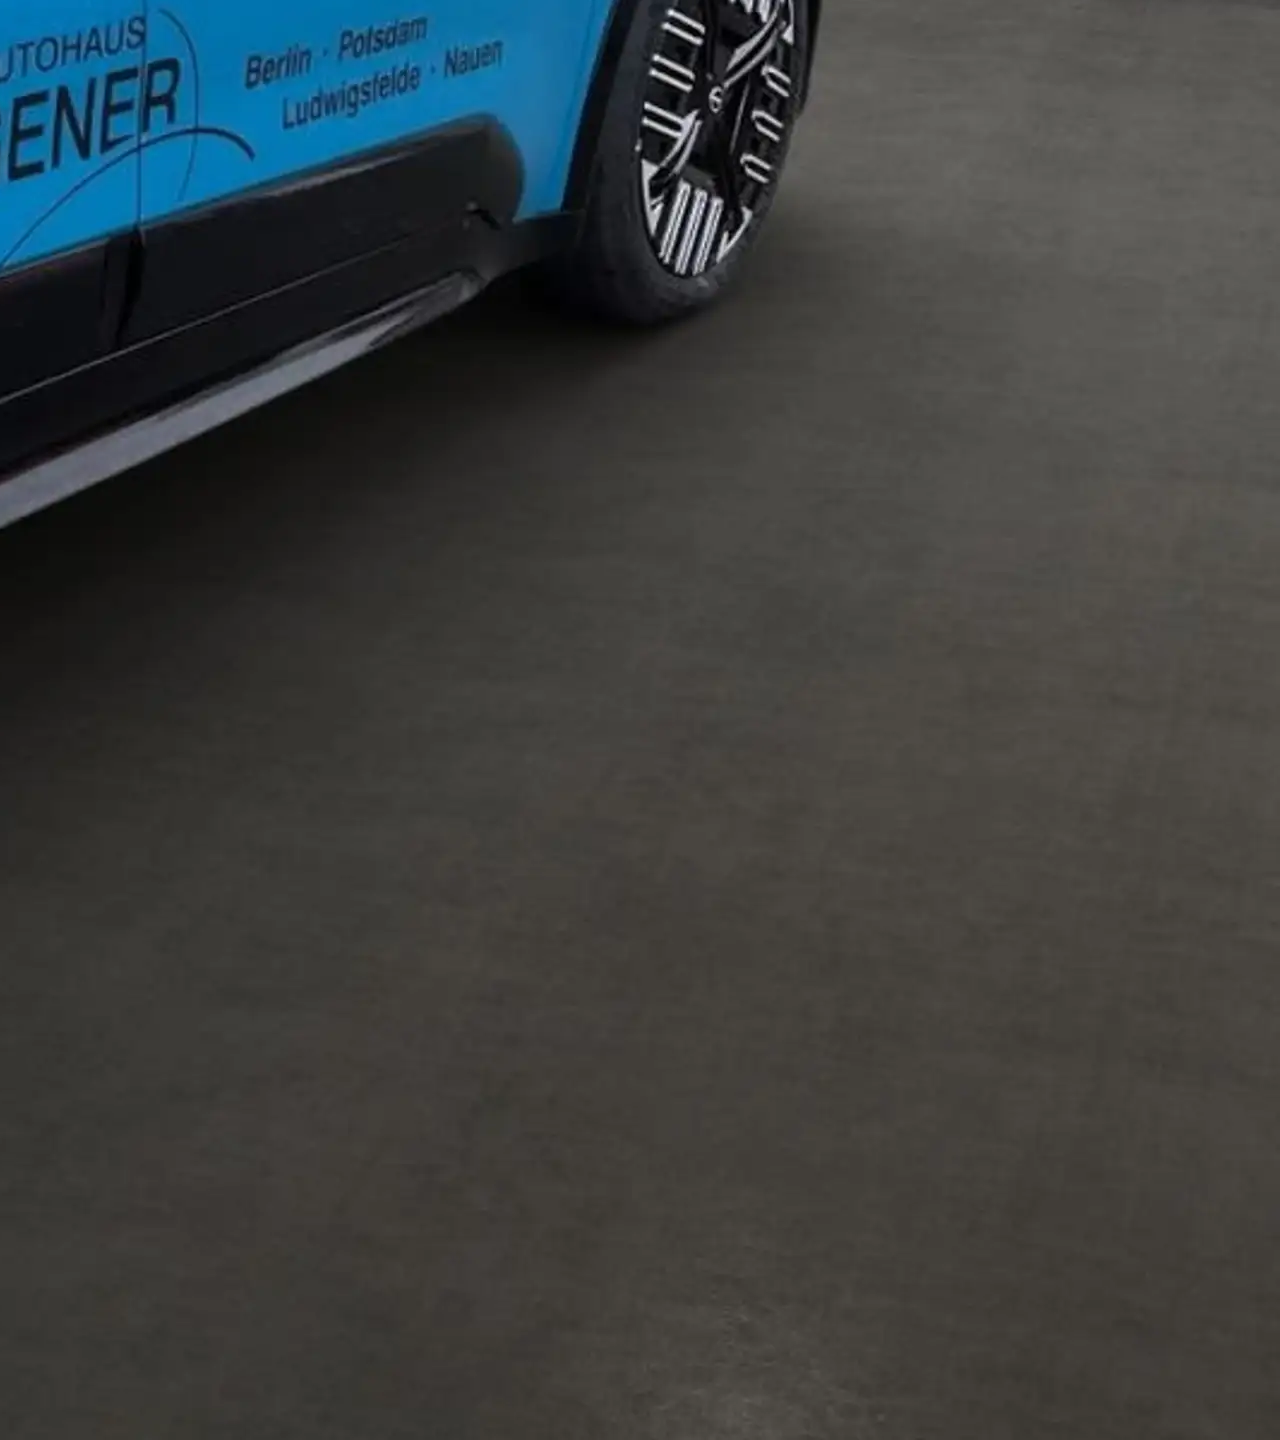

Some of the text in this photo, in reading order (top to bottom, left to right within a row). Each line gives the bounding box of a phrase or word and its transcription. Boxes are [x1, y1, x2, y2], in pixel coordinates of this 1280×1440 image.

[244, 16, 429, 90] Berlin Potsdam
[281, 39, 504, 130] Ludwigsfelde Nauen
